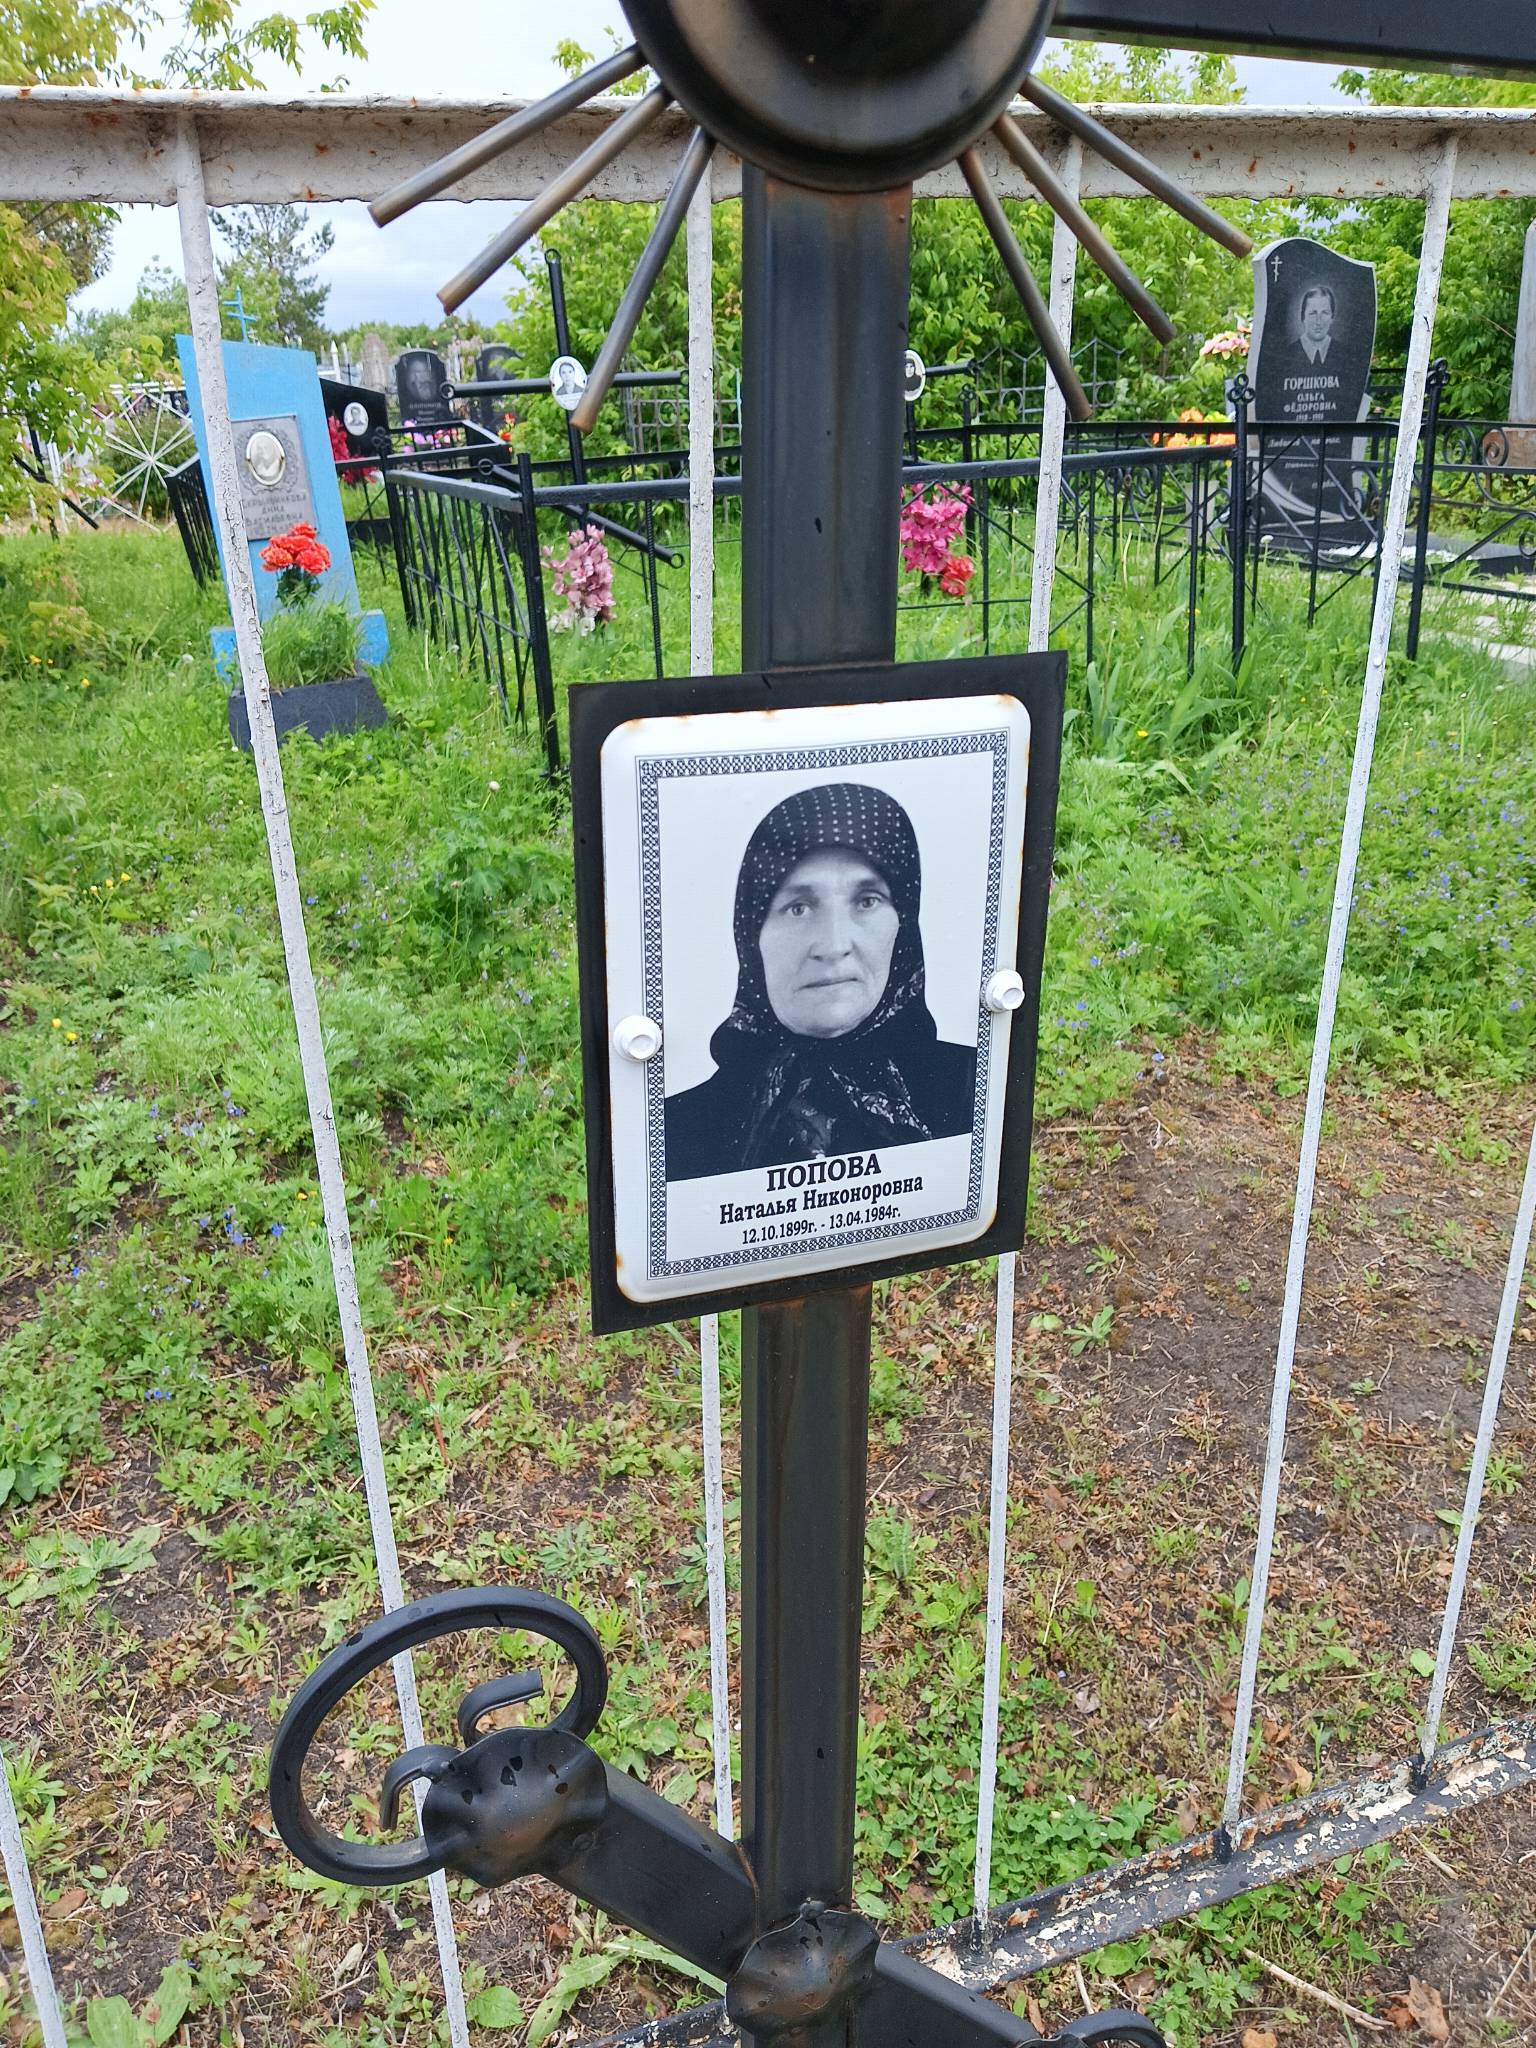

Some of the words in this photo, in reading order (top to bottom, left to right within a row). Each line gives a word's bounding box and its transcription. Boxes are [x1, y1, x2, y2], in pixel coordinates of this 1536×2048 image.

[1284, 376, 1339, 390] ГОРШКОВА
[1297, 393, 1324, 402] ОЛЬГА
[766, 1153, 881, 1192] ПОПОВА
[719, 1197, 797, 1225] Наталья
[802, 1176, 924, 1211] Никоноровна
[742, 1219, 818, 1245] 12.10.1899г.
[829, 1204, 901, 1230] 13.04.1984г.
